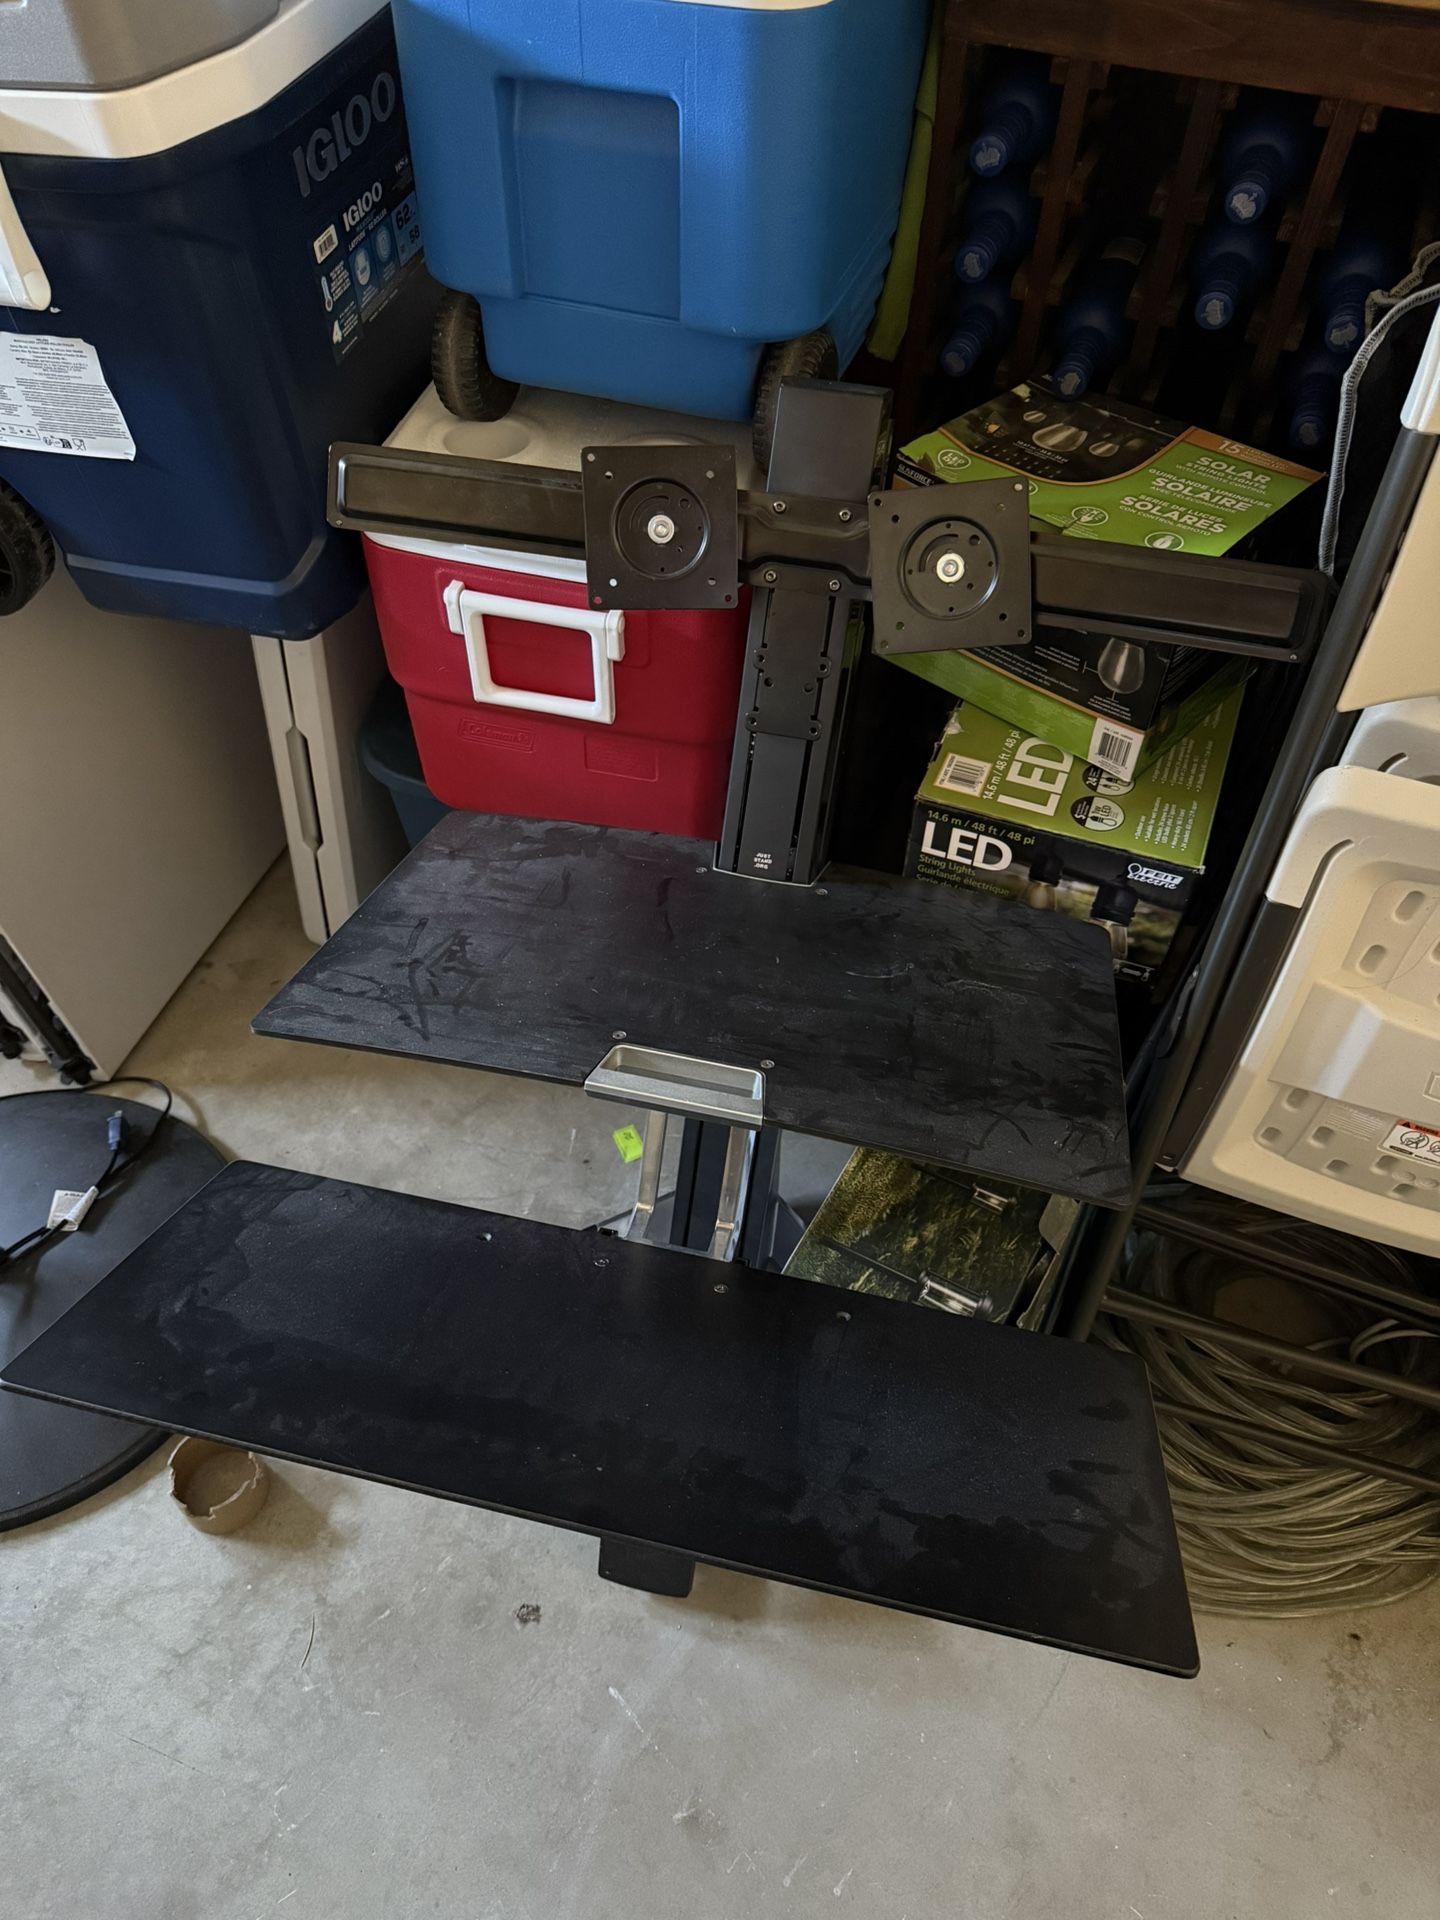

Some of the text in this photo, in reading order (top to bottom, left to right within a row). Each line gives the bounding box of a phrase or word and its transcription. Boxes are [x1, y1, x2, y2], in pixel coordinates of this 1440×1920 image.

[293, 72, 395, 197] IGLOO
[343, 182, 382, 232] IGLOO
[396, 203, 410, 230] 62
[333, 320, 342, 344] 4
[1217, 440, 1241, 454] 15
[1175, 464, 1267, 495] WITH REMOTE CONTROL
[1185, 462, 1268, 490] STRING LIGHTS
[1196, 456, 1271, 485] SOLAR
[1148, 468, 1273, 509] GUIRLANDE LUMINEUSE
[1150, 486, 1170, 495] AVEC
[1152, 477, 1253, 512] SOLAIRE
[1119, 505, 1137, 515] CON
[1137, 511, 1175, 527] CONTROL
[1176, 522, 1212, 536] REMOTO
[1120, 496, 1227, 534] SOLARES
[1138, 494, 1224, 523] SERIE DE LUCES
[1004, 736, 1017, 749] 48
[1009, 729, 1021, 738] pi
[995, 760, 1008, 773] 48
[999, 752, 1010, 761] ft
[992, 777, 1000, 786] m
[997, 736, 1074, 817] LED
[1086, 774, 1097, 786] 24
[983, 784, 997, 800] 14.6
[1099, 804, 1112, 817] LED
[927, 810, 949, 822] 14.6
[951, 817, 962, 825] m
[971, 821, 986, 832] 48
[988, 825, 998, 835] ft
[1007, 831, 1022, 841] 48
[1023, 836, 1036, 846] pi
[921, 820, 1012, 871] LED
[919, 854, 976, 877] String Lights
[917, 864, 961, 881] Guirlande
[963, 875, 1010, 896] électrique
